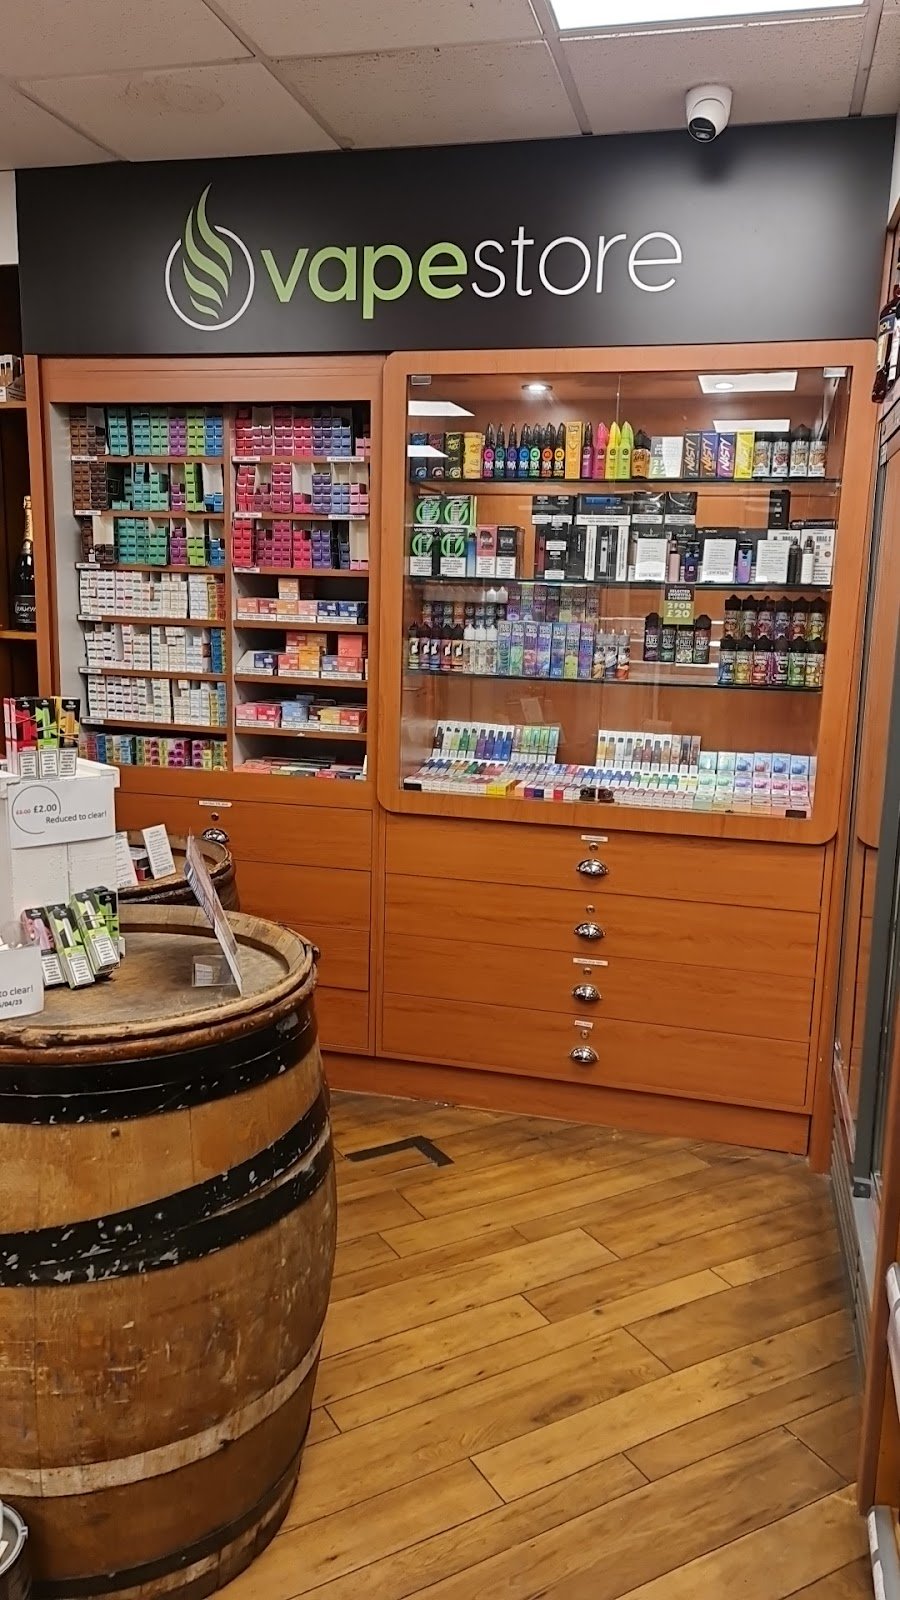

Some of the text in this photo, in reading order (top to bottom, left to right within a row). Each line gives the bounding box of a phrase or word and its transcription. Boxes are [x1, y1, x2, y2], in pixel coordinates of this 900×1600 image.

[684, 437, 697, 471] NASTY
[700, 436, 713, 472] NASTY
[718, 437, 731, 471] NASTY
[666, 609, 691, 618] £20
[33, 803, 57, 814] £2.00
[45, 810, 107, 824] Reduced to clear!
[9, 984, 34, 996] clear!
